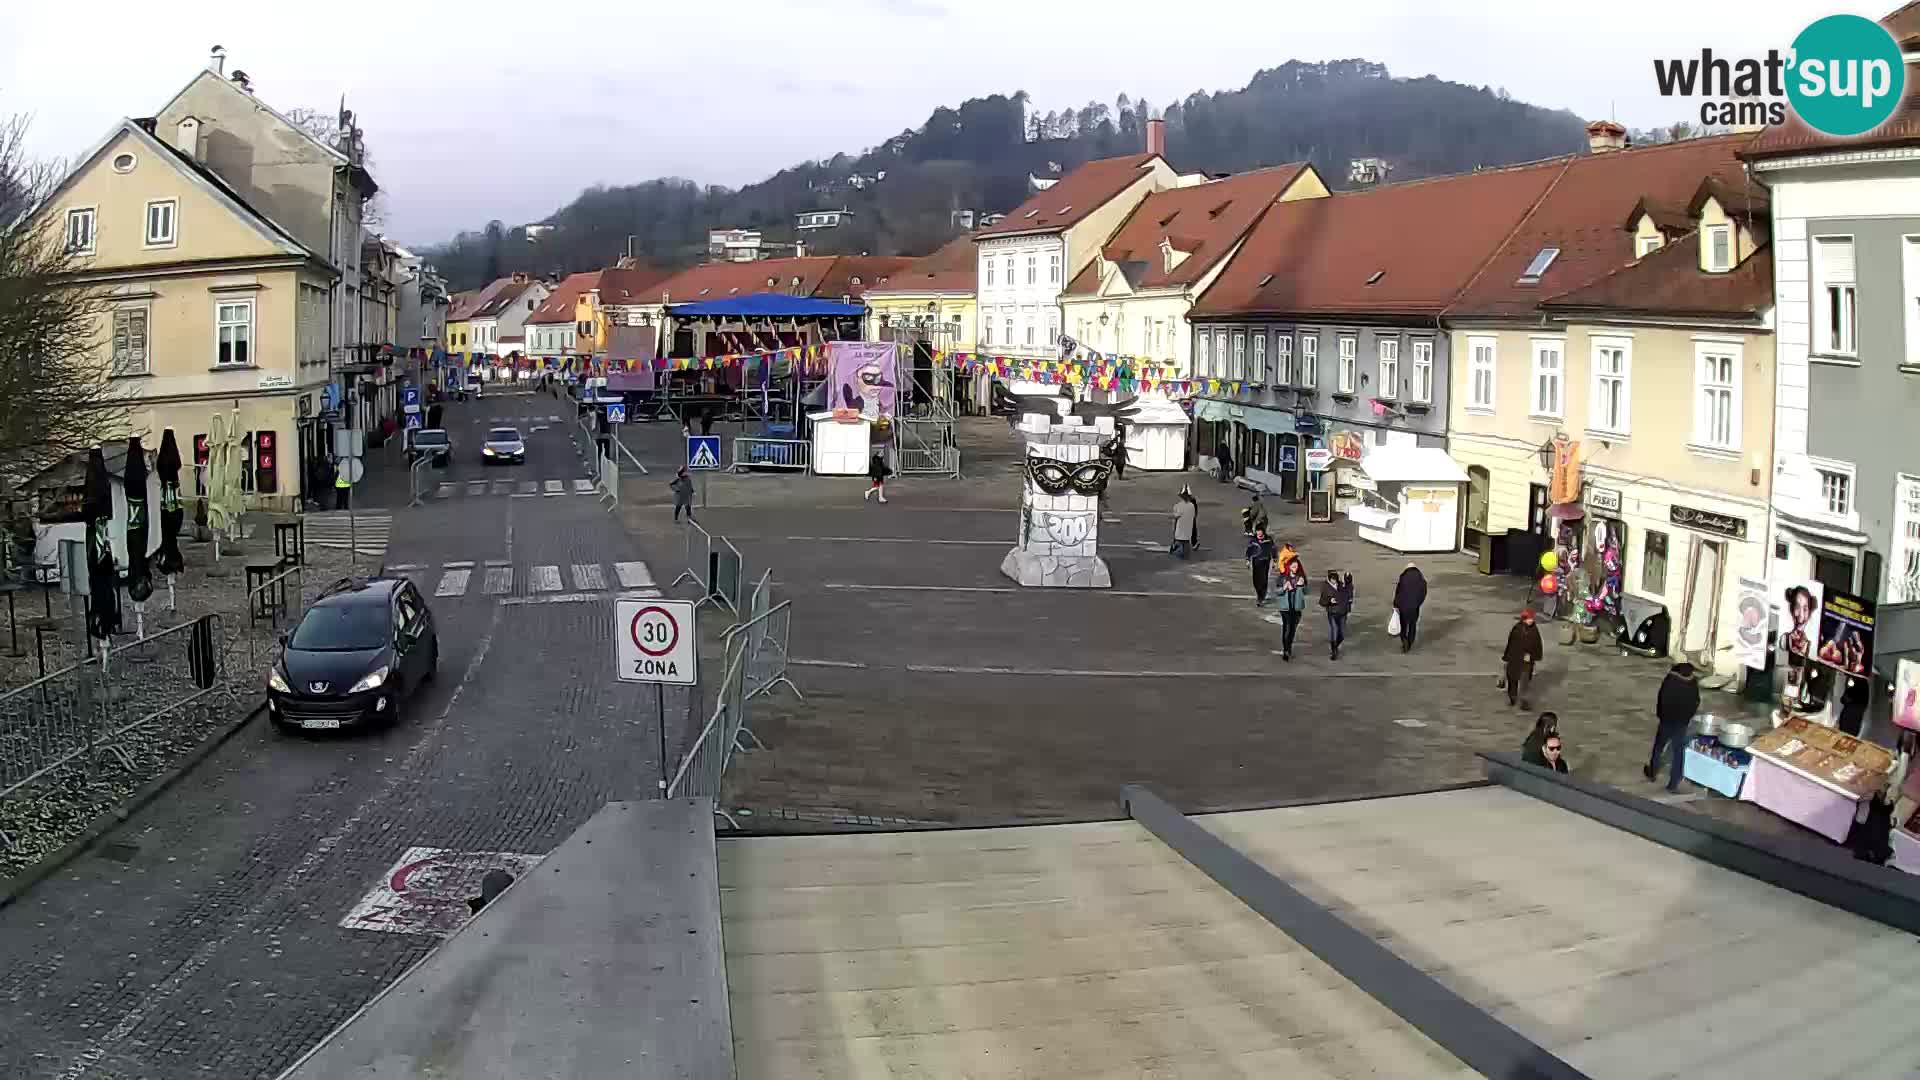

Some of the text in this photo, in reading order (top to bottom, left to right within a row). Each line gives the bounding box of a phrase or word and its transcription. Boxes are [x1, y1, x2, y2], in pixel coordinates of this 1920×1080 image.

[407, 391, 416, 402] P
[643, 622, 667, 643] 30
[633, 659, 679, 677] ZONA
